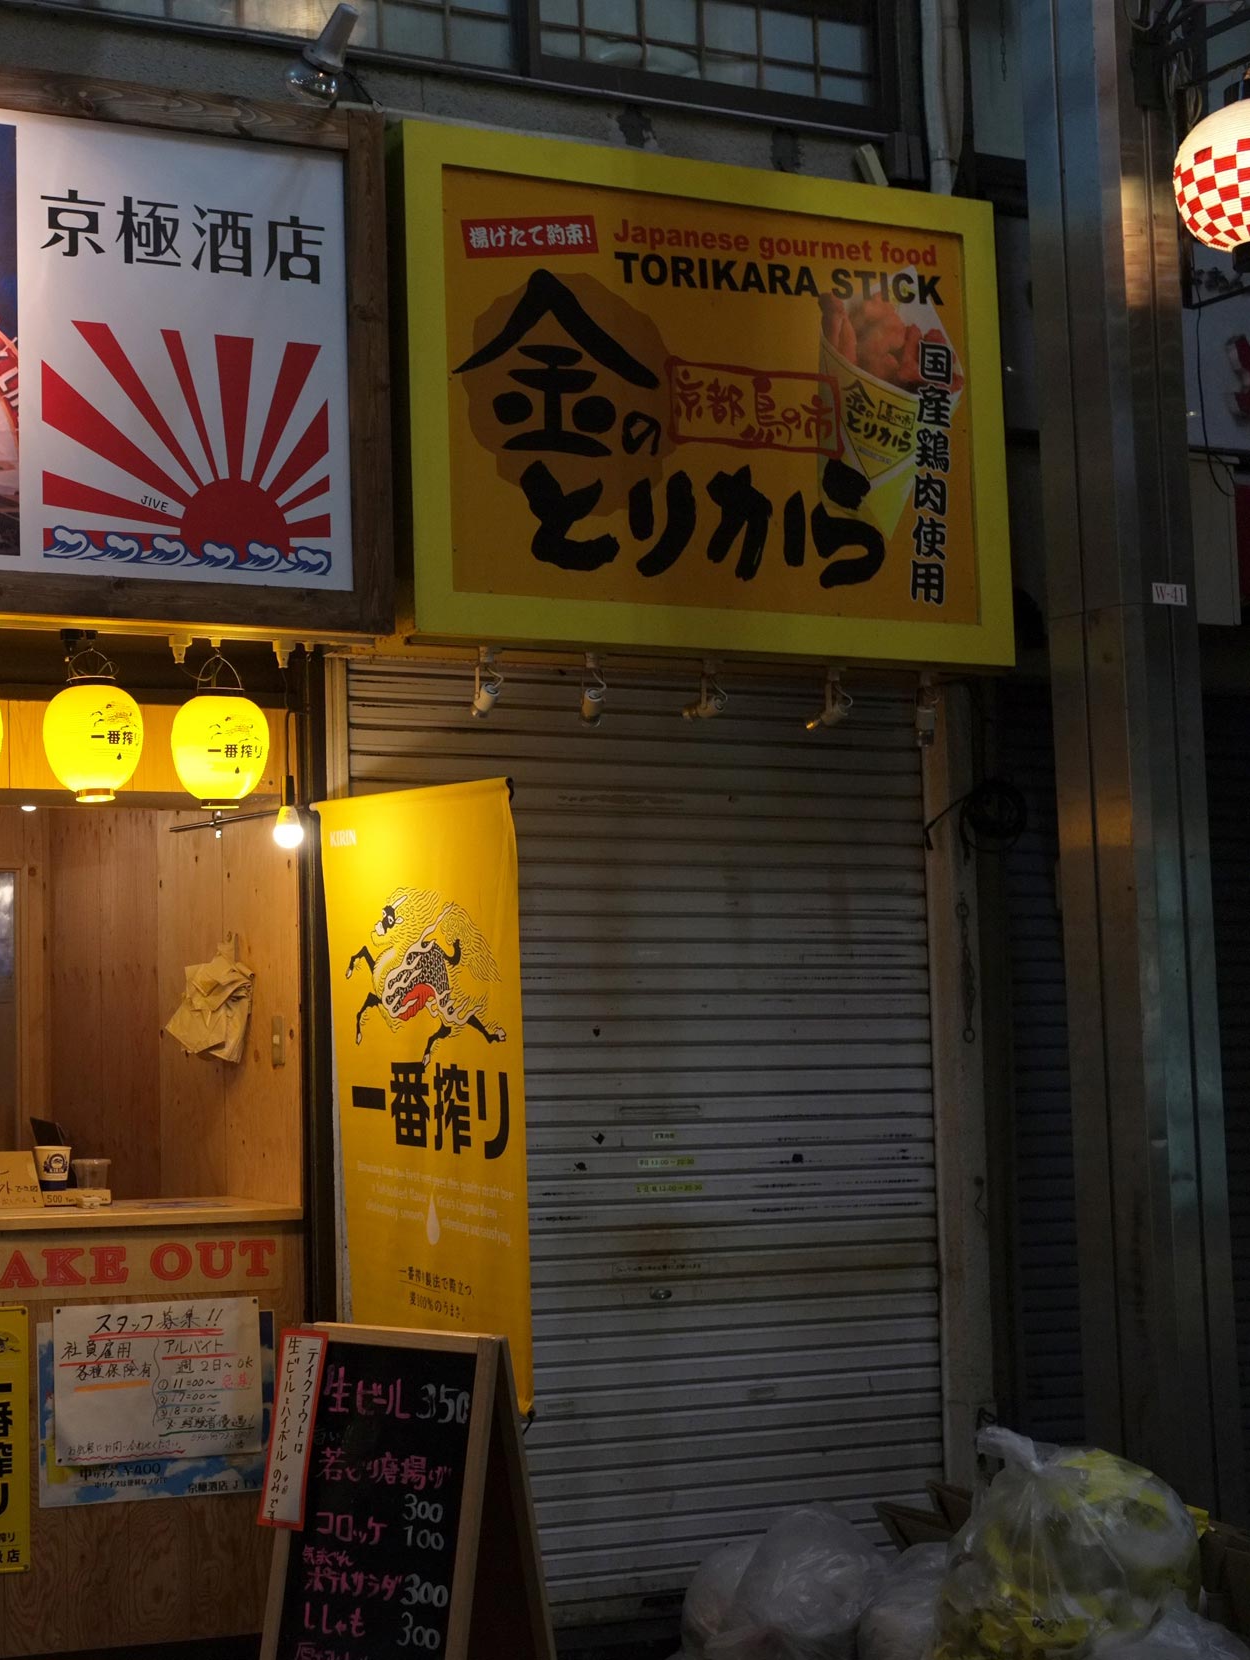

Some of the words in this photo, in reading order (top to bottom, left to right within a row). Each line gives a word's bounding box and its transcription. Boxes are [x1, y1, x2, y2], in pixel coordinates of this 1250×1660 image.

[40, 189, 325, 285] 京極酒店
[613, 219, 749, 253] Japanese
[758, 235, 872, 263] gourmet
[879, 240, 938, 267] food
[614, 251, 820, 298] TORIKARA
[831, 268, 944, 306] STICK
[911, 340, 952, 606] 国産鶏肉使用
[140, 495, 169, 513] JIVE
[519, 458, 886, 589] とりから
[208, 744, 263, 758] 一番搾り
[330, 830, 357, 848] KIRIN
[352, 1062, 510, 1160] 一番搾り
[46, 1194, 63, 1203] 500
[150, 1239, 276, 1281] OUT
[164, 1338, 224, 1355] アルバイト
[323, 1364, 412, 1419] 生ビール
[416, 1382, 471, 1424] 350
[402, 1494, 444, 1524] 300
[316, 1511, 389, 1546] コロッケ
[403, 1525, 445, 1551] 100
[401, 1572, 448, 1608] 300
[303, 1601, 367, 1638] ししゃも
[396, 1611, 441, 1651] 300
